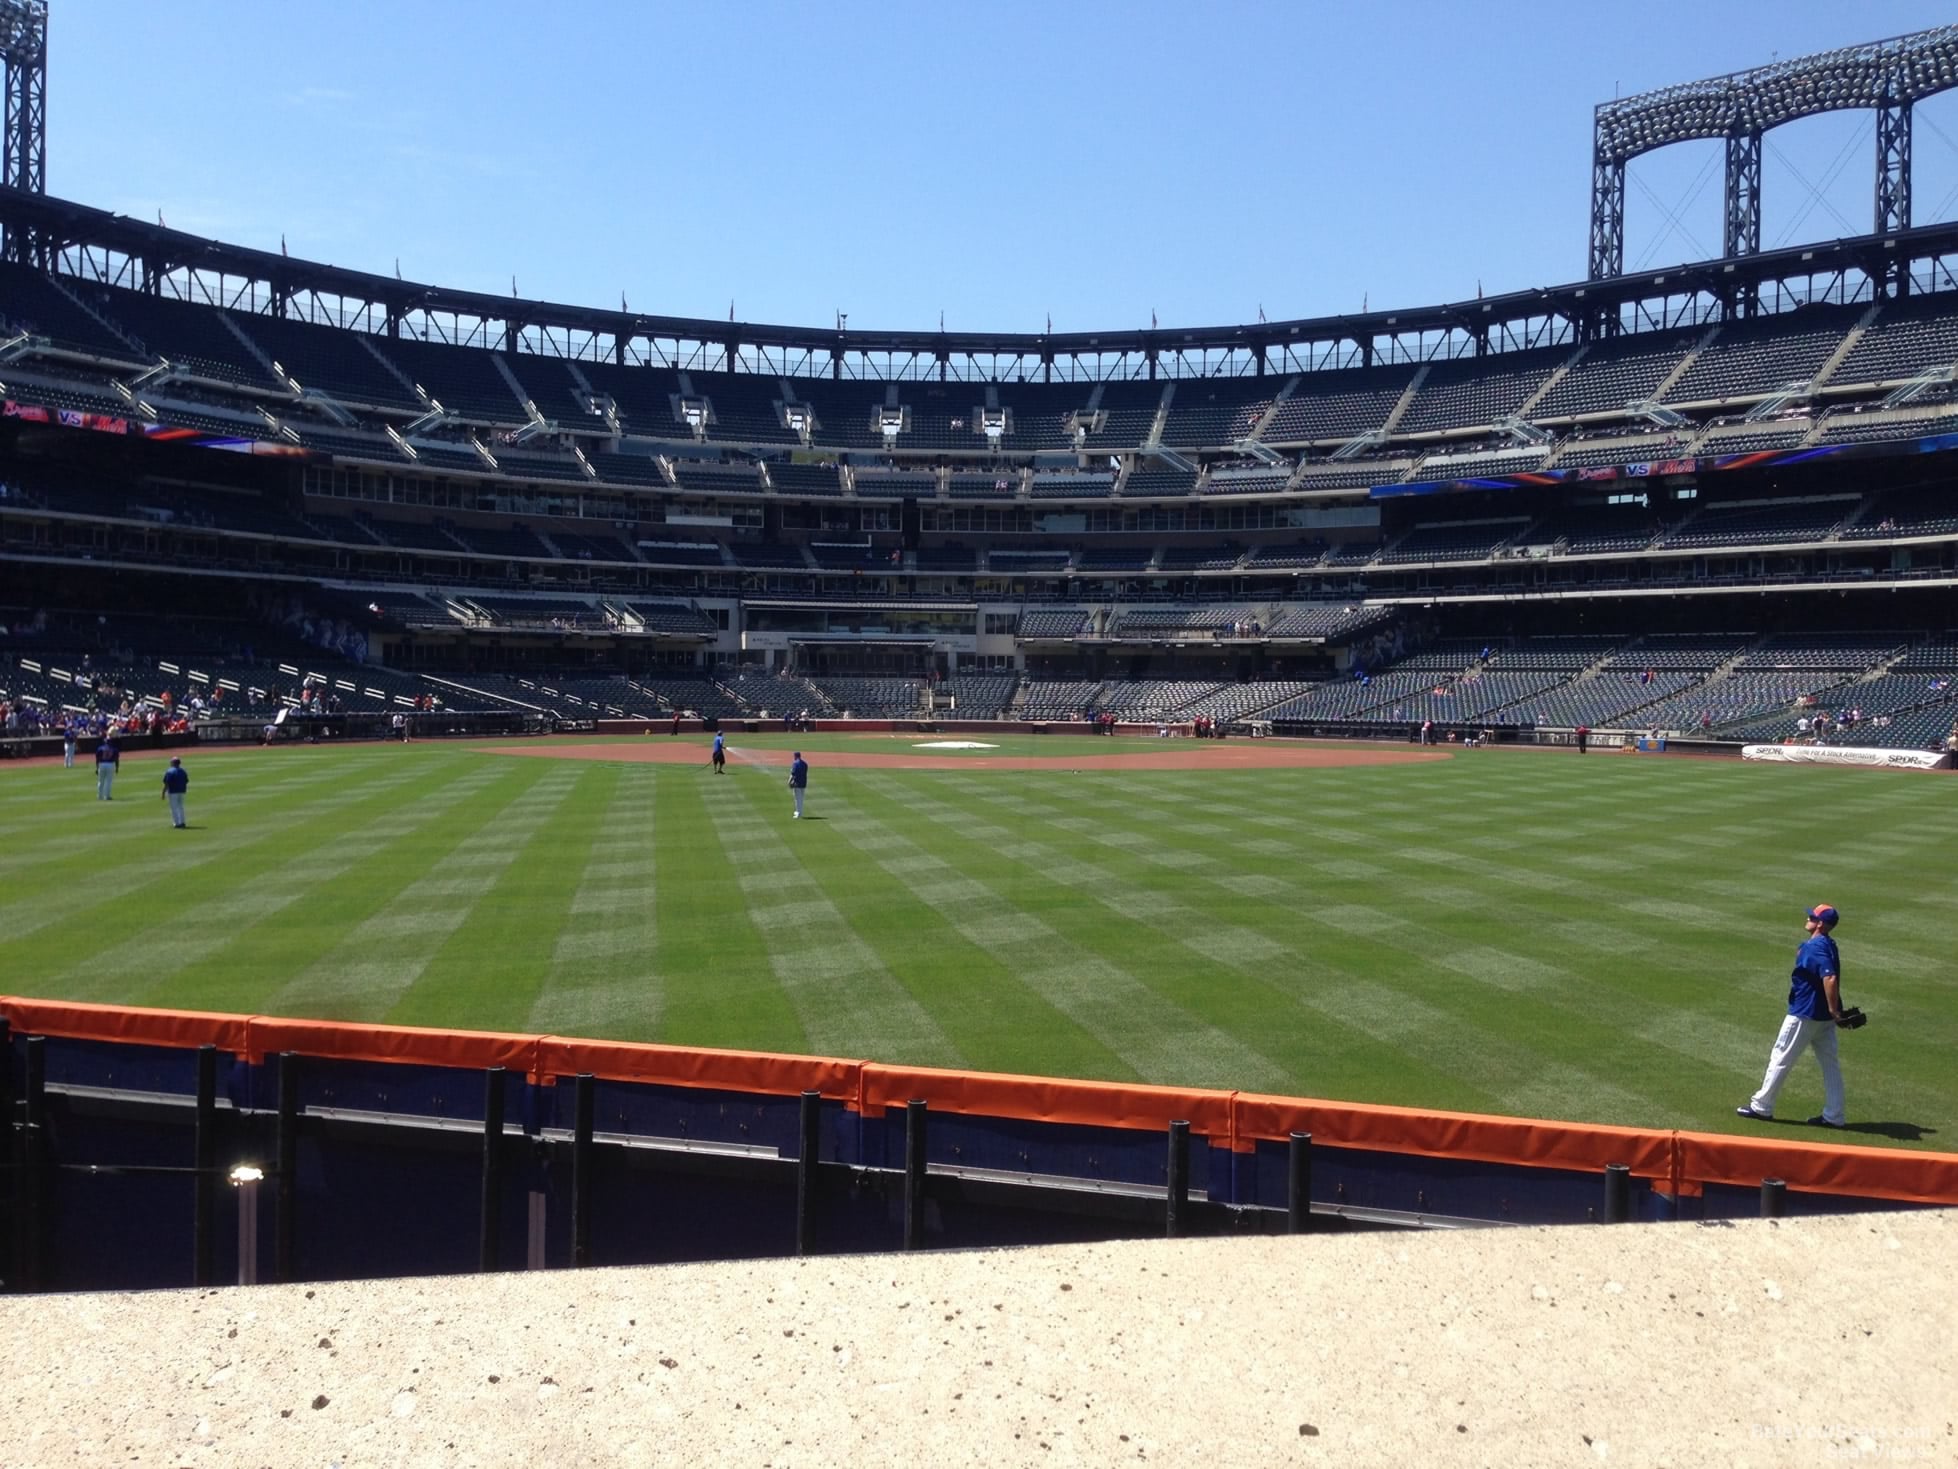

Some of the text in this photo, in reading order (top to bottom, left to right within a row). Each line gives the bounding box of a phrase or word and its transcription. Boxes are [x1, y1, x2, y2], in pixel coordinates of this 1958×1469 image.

[60, 411, 81, 425] VS
[1627, 464, 1649, 475] VS
[1887, 754, 1919, 764] SPDR
